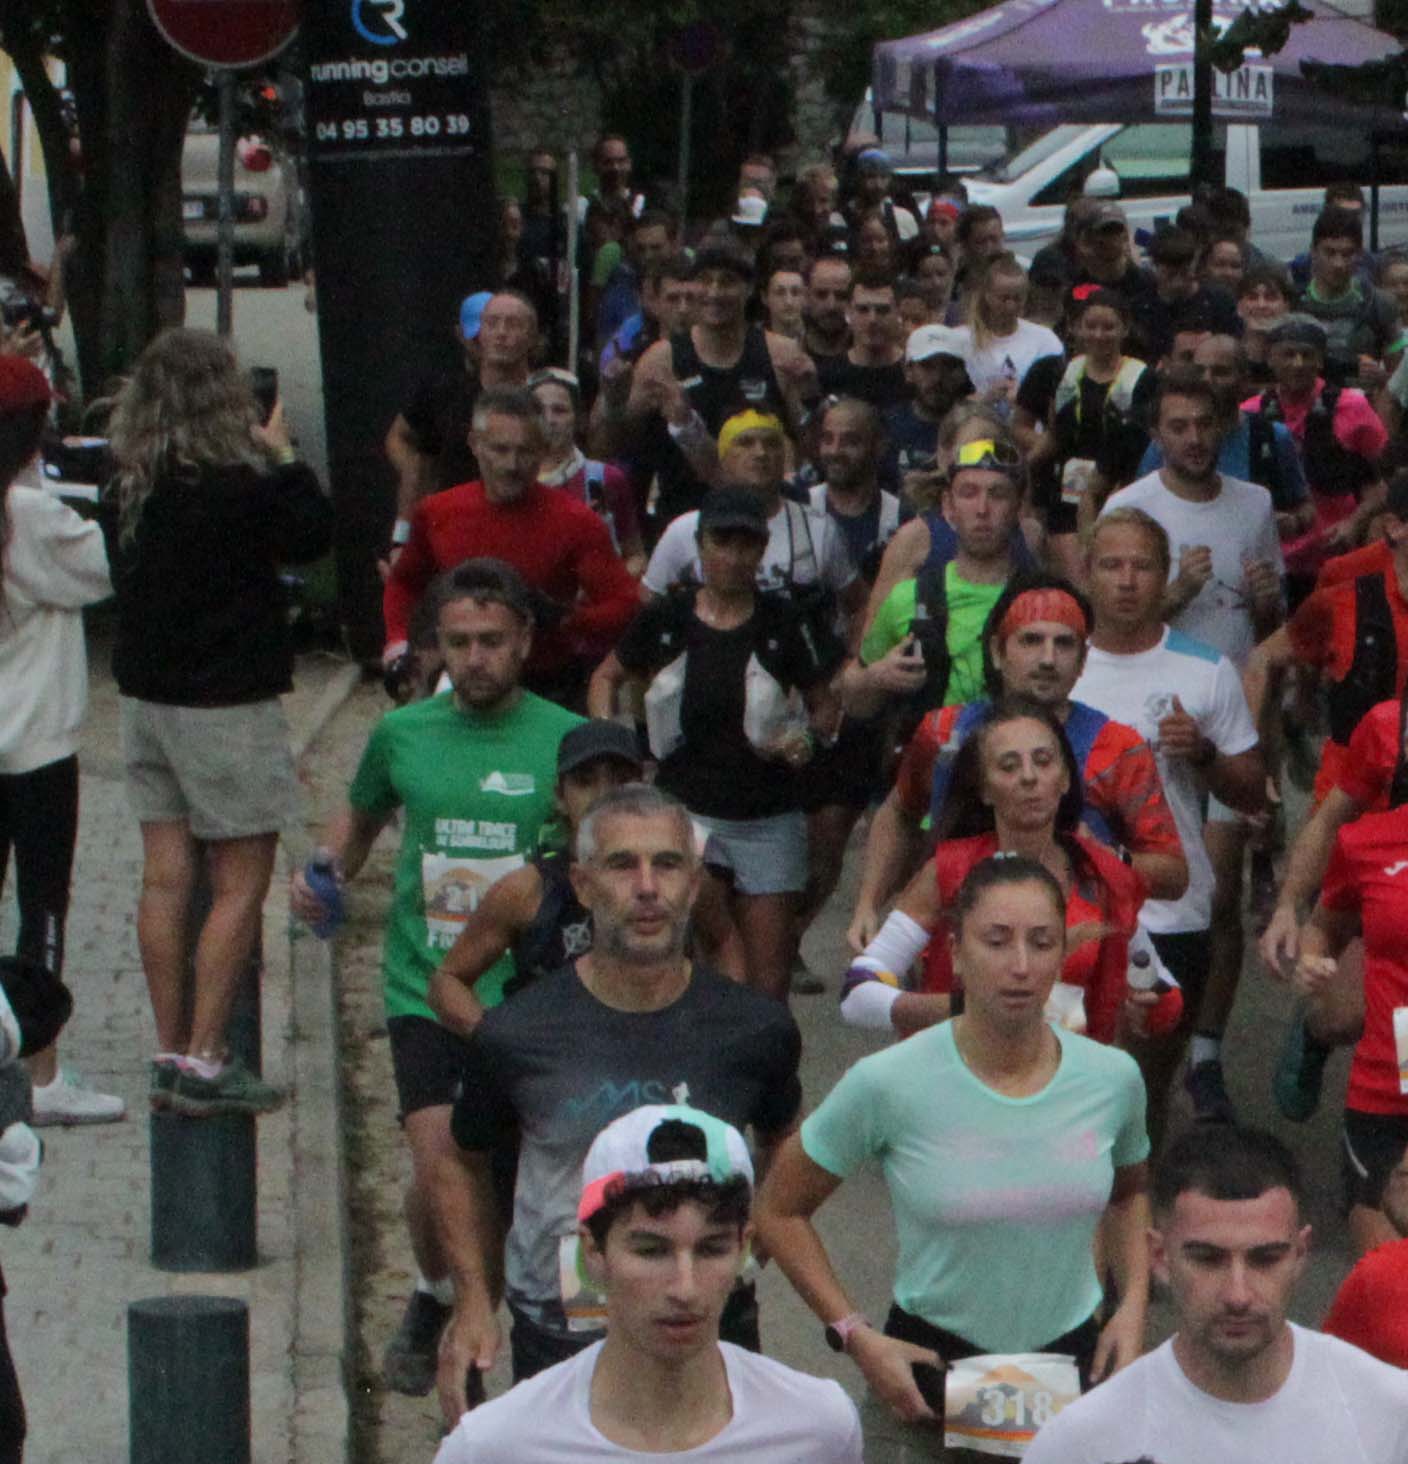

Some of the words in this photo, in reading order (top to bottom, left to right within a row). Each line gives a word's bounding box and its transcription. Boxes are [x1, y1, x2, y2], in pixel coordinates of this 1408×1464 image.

[1160, 68, 1268, 99] PALINA
[316, 121, 338, 142] 04
[341, 119, 369, 140] 95
[375, 117, 403, 138] 35
[410, 115, 440, 136] 80
[446, 114, 471, 134] 39
[446, 885, 479, 913] 21
[981, 1387, 1055, 1427] 318
